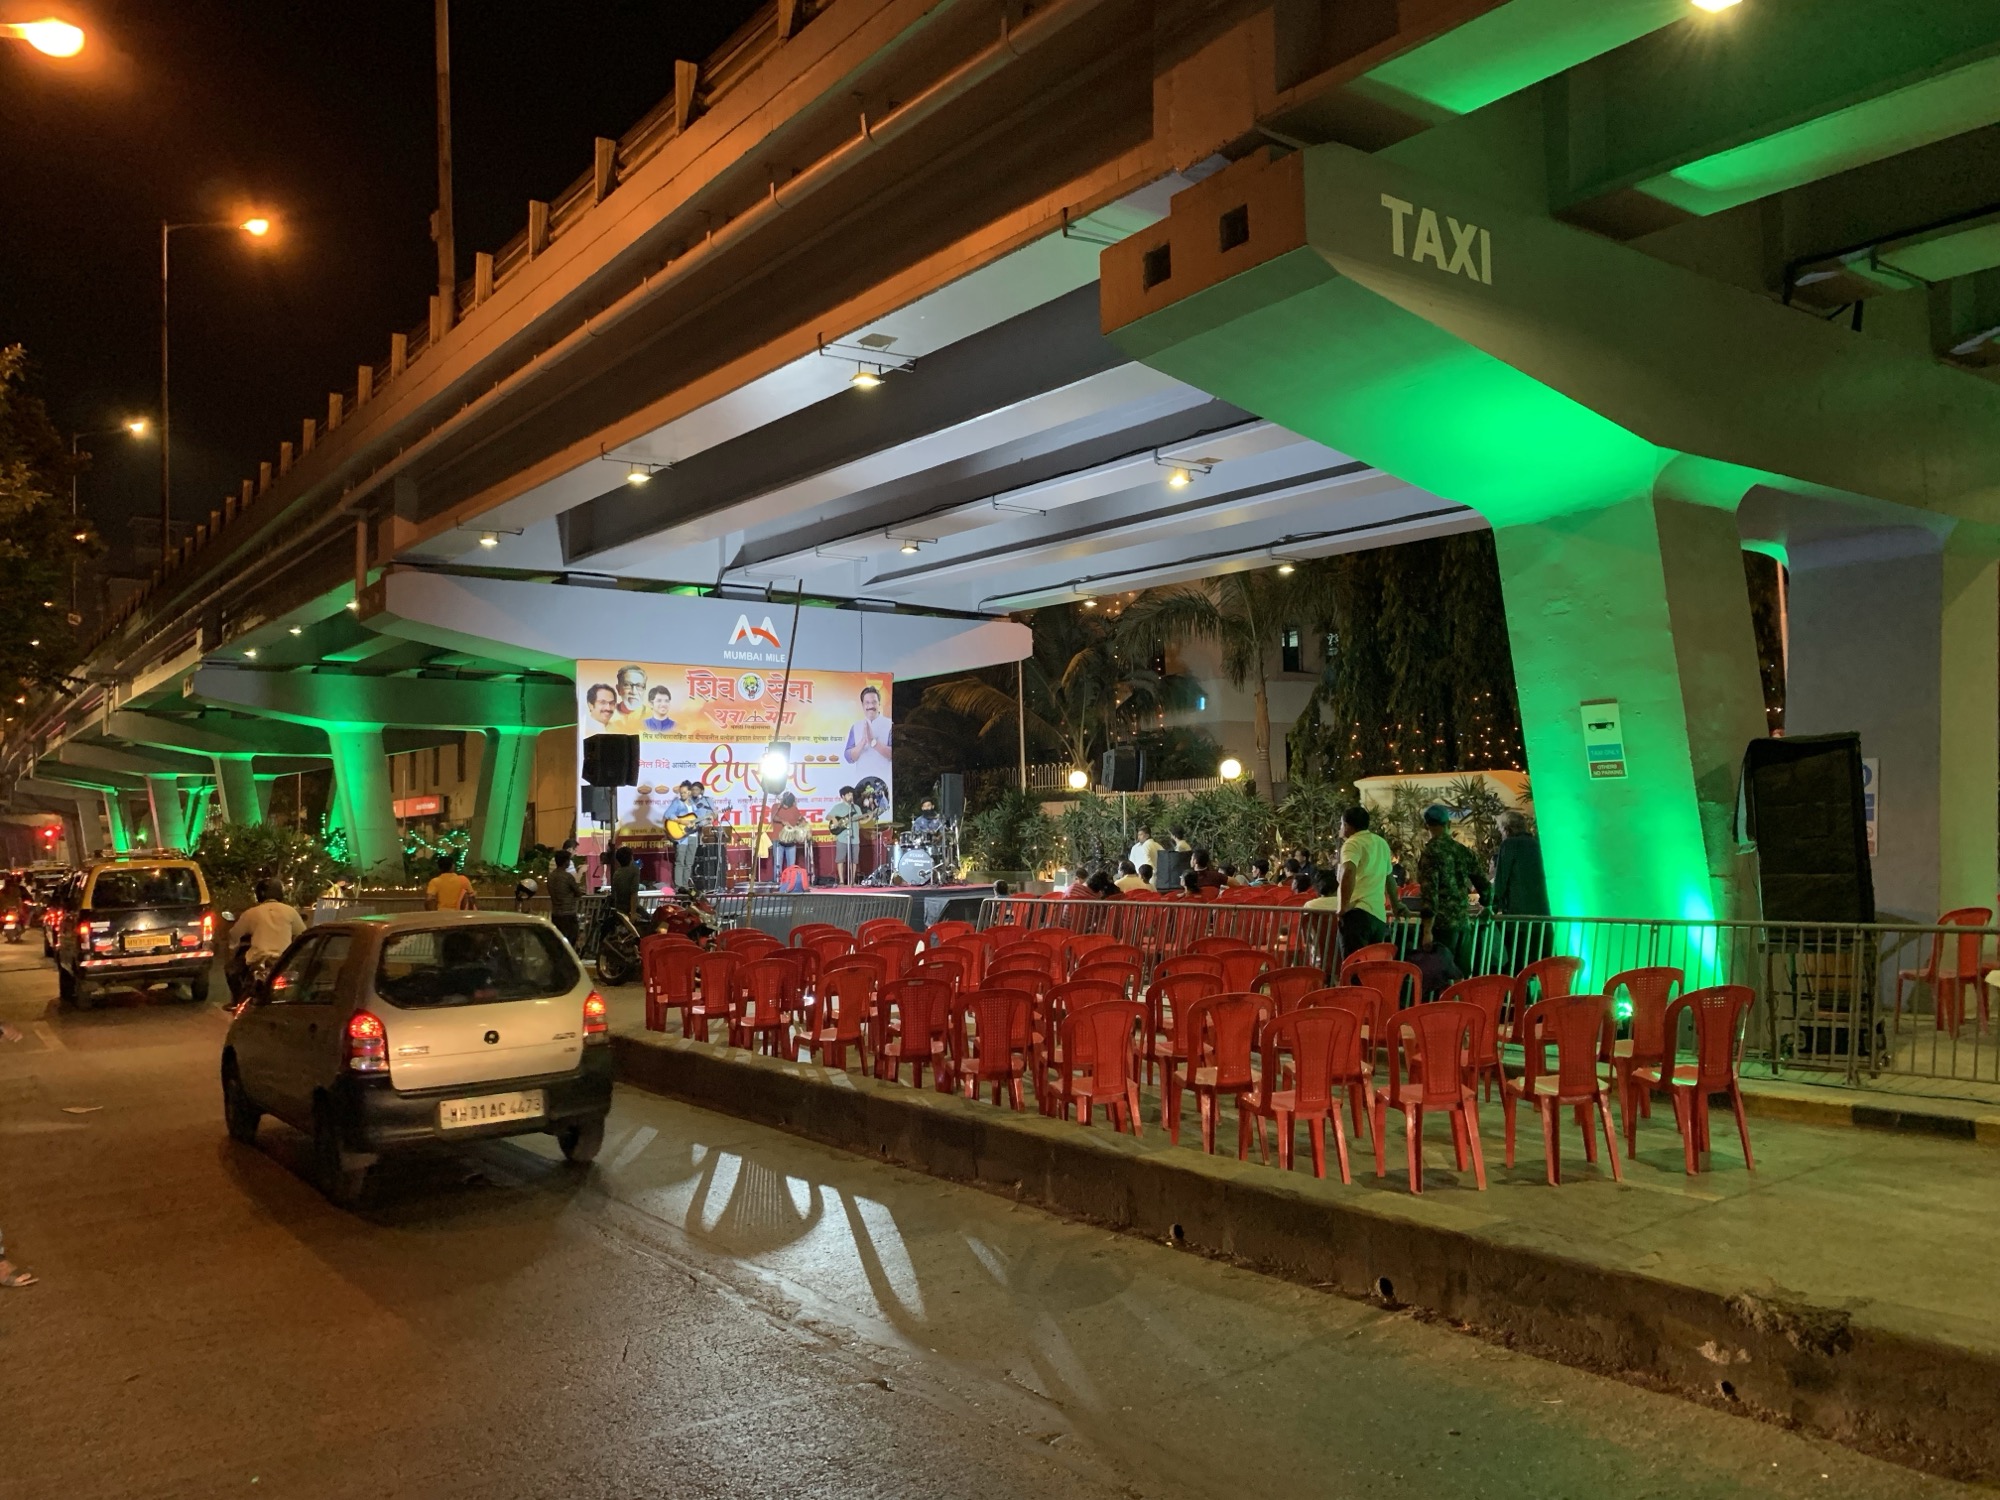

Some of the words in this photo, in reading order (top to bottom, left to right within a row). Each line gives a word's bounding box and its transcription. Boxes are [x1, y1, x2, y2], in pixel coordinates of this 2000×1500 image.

[1380, 192, 1492, 286] TAXI
[723, 650, 763, 662] MUMBAI
[765, 653, 786, 663] MILE
[686, 669, 735, 702] शिव
[766, 673, 814, 703] सेना
[713, 708, 747, 728] युवा
[761, 702, 797, 725] सेना
[490, 1102, 506, 1117] AC
